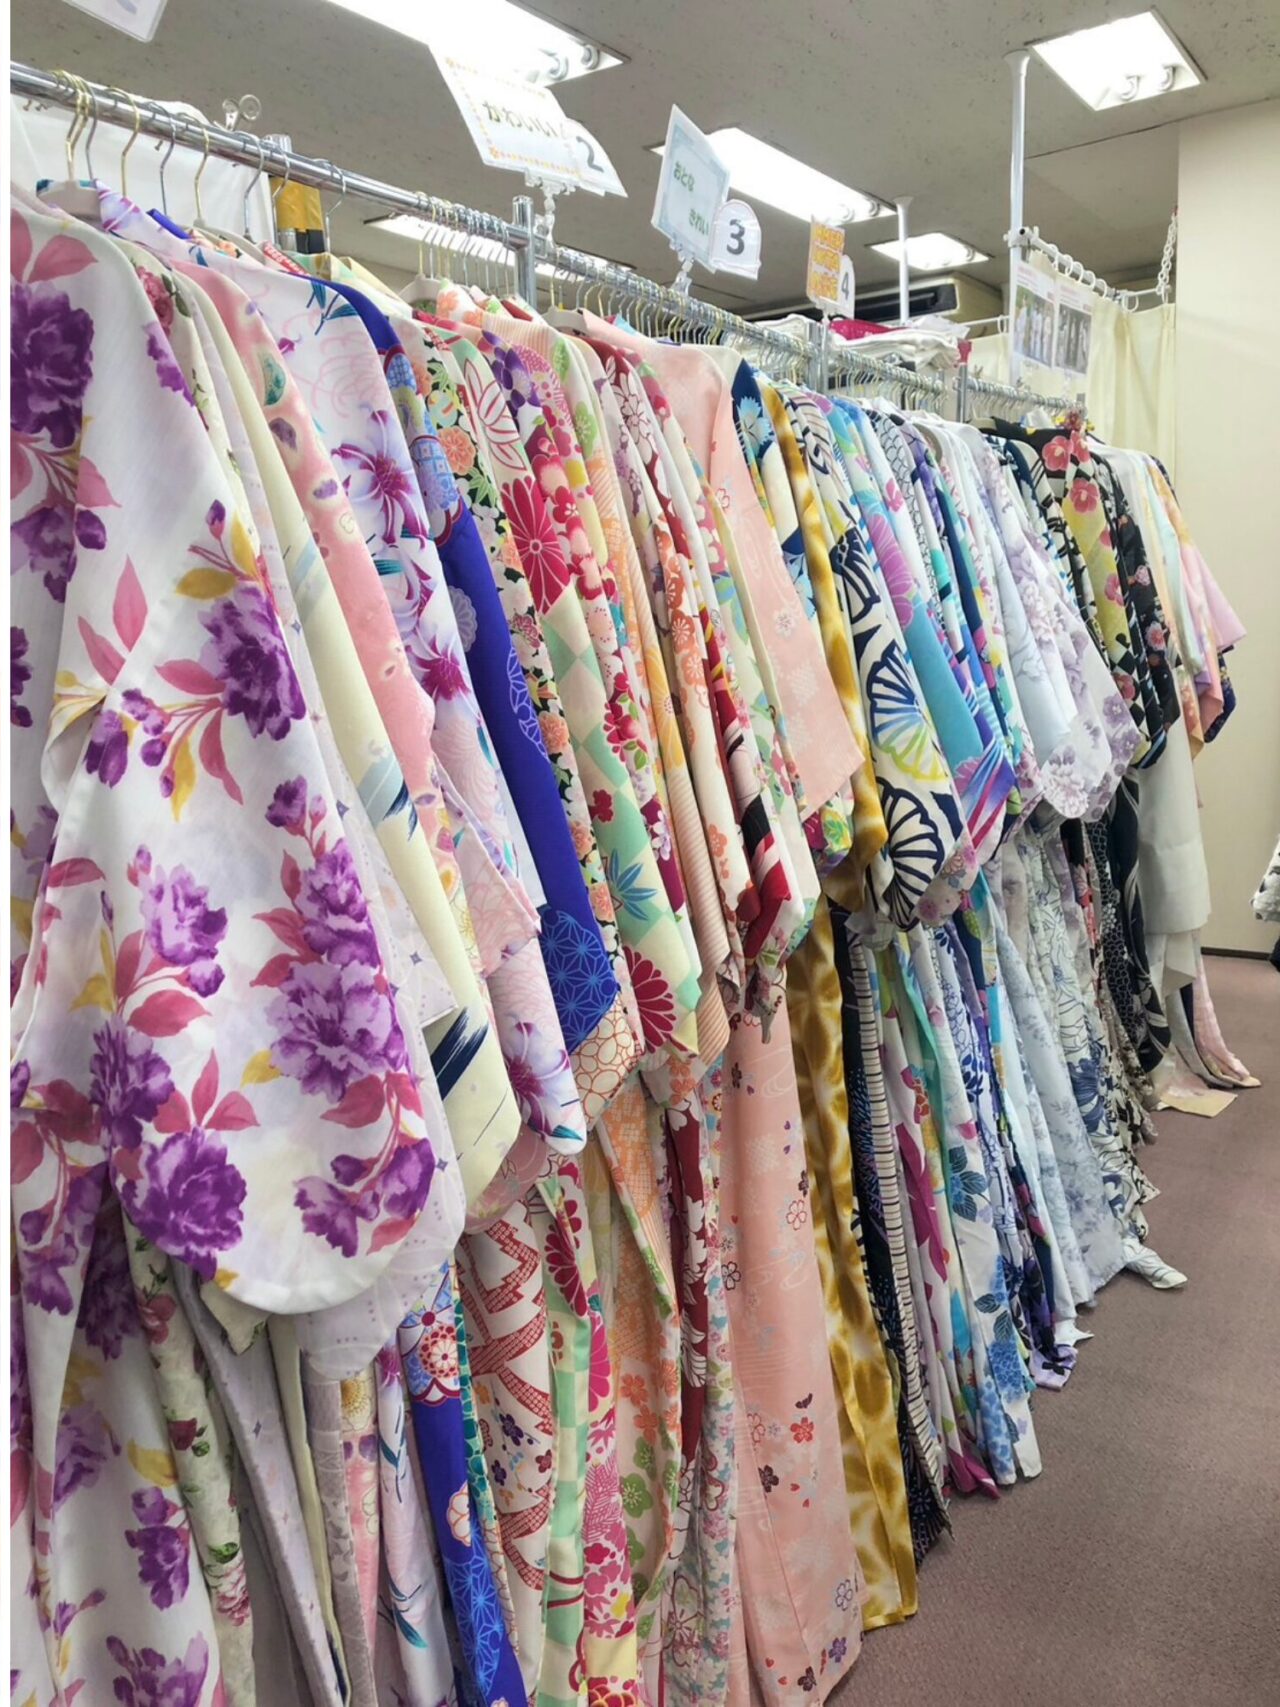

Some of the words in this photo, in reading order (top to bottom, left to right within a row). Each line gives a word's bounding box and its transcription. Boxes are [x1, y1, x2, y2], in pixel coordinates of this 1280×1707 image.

[576, 135, 605, 174] 2
[726, 218, 746, 256] 3
[841, 271, 850, 301] 4
